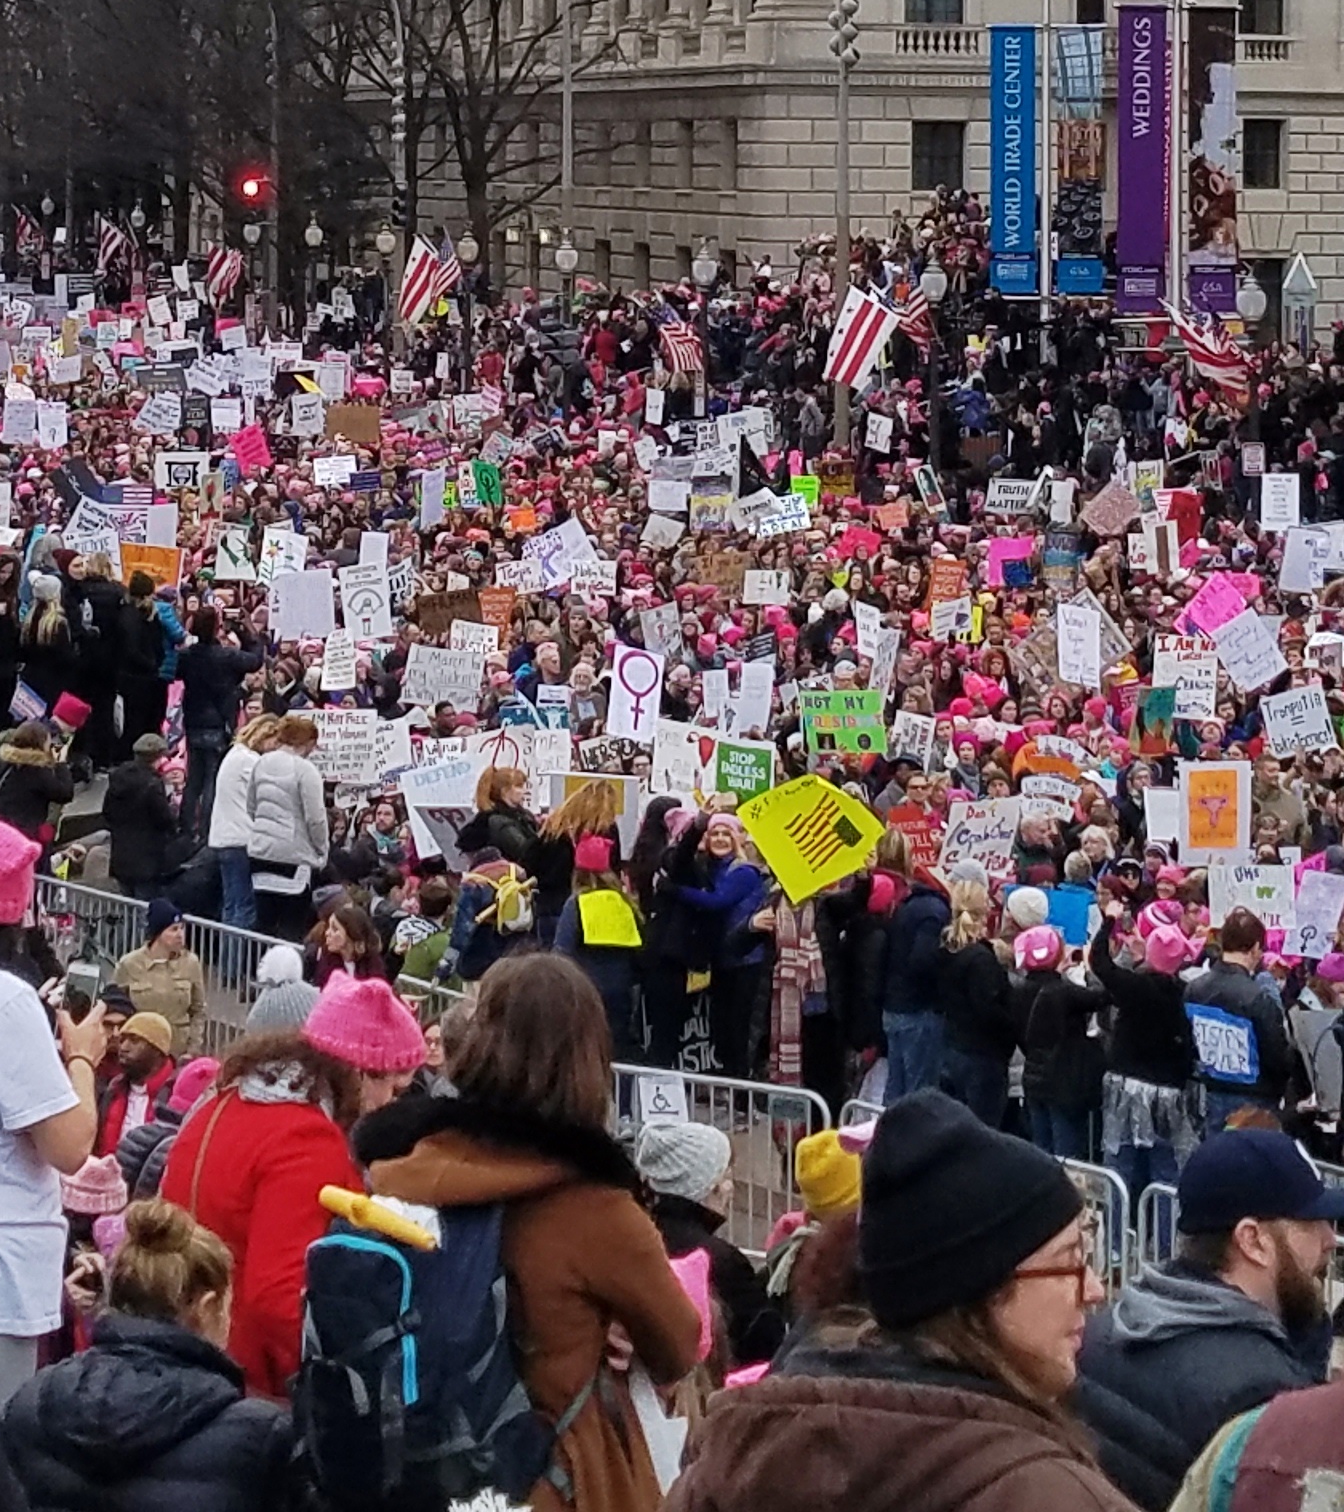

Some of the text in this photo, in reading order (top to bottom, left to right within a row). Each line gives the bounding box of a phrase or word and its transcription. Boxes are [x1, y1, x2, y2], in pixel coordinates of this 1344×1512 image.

[1004, 36, 1022, 109] CENTER
[1133, 16, 1152, 139] WEDDINGS
[1004, 114, 1022, 174] TRADE
[1004, 176, 1022, 248] WORLD
[1158, 635, 1170, 653] I
[1173, 635, 1195, 652] AM
[803, 695, 865, 710] NOT MY
[729, 750, 756, 765] STOP
[413, 761, 471, 787] DEFEND
[720, 760, 766, 780] ENDLESS
[907, 832, 932, 848] TILL
